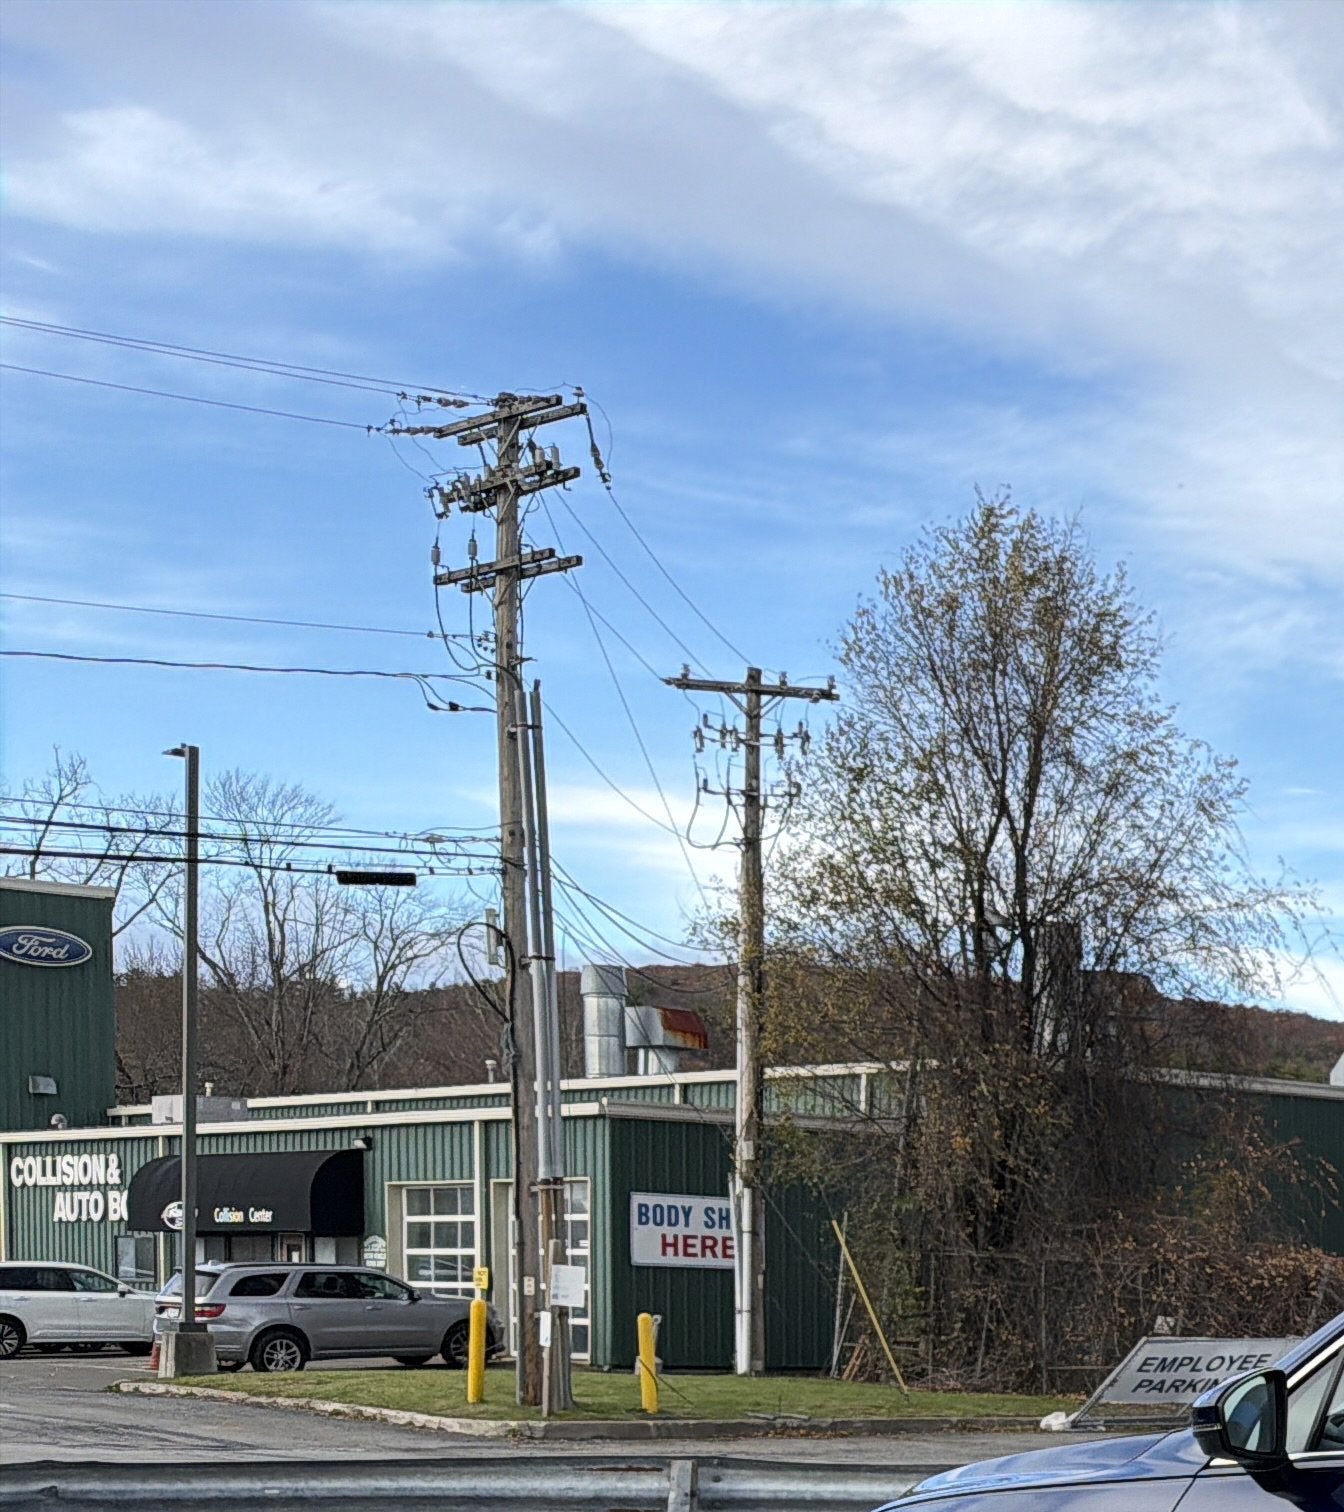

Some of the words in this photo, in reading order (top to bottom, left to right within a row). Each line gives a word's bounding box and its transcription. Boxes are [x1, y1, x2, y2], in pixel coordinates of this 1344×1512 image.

[12, 934, 70, 959] Ford
[10, 1154, 106, 1187] COLLISION
[106, 1153, 121, 1185] &
[53, 1190, 105, 1222] AUTO
[214, 1207, 244, 1223] Collision
[248, 1207, 273, 1223] Center
[637, 1203, 693, 1228] BODY
[703, 1206, 731, 1230] SH
[660, 1233, 735, 1259] HERE
[1136, 1353, 1272, 1373] EMPLOYEE
[1131, 1378, 1228, 1393] PARKIN
